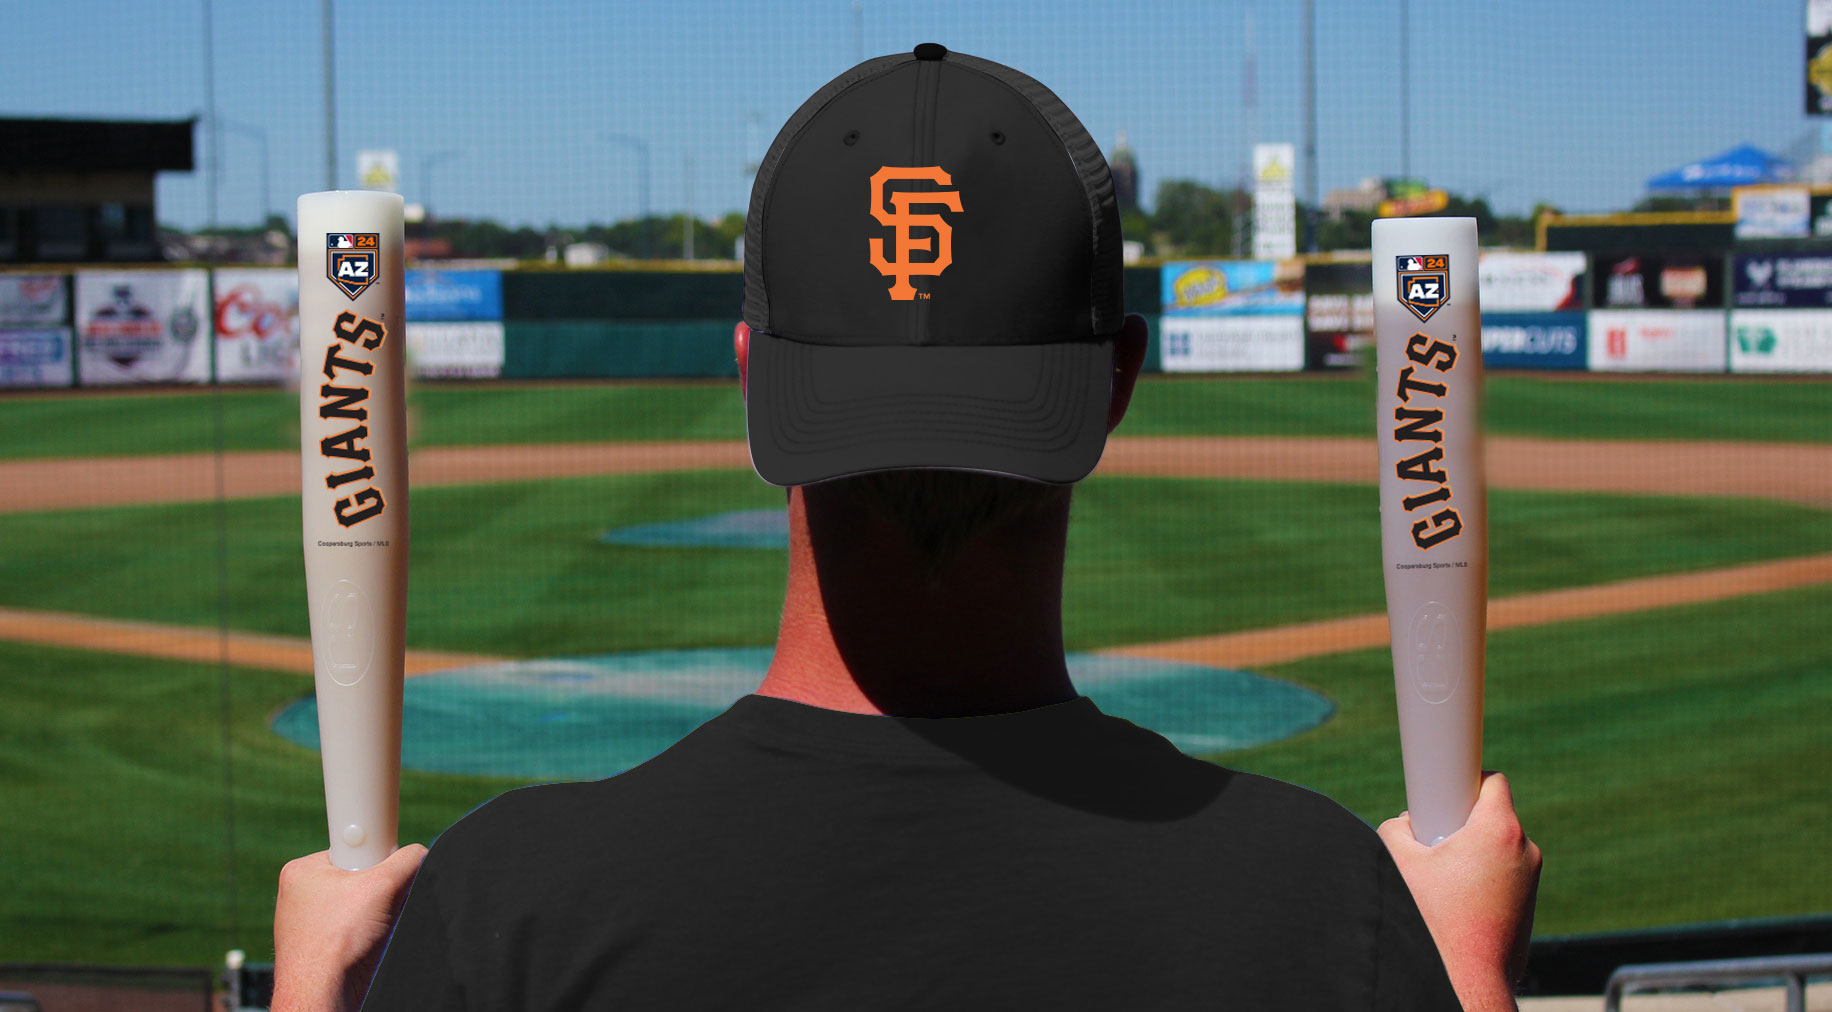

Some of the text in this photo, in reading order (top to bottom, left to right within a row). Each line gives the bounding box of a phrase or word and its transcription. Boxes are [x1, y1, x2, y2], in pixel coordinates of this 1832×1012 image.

[357, 236, 375, 247] 24
[338, 261, 369, 277] AZ
[1427, 258, 1445, 269] 24
[1408, 283, 1440, 300] AZ
[319, 309, 388, 529] GIANTS
[1393, 331, 1464, 551] GIANTS
